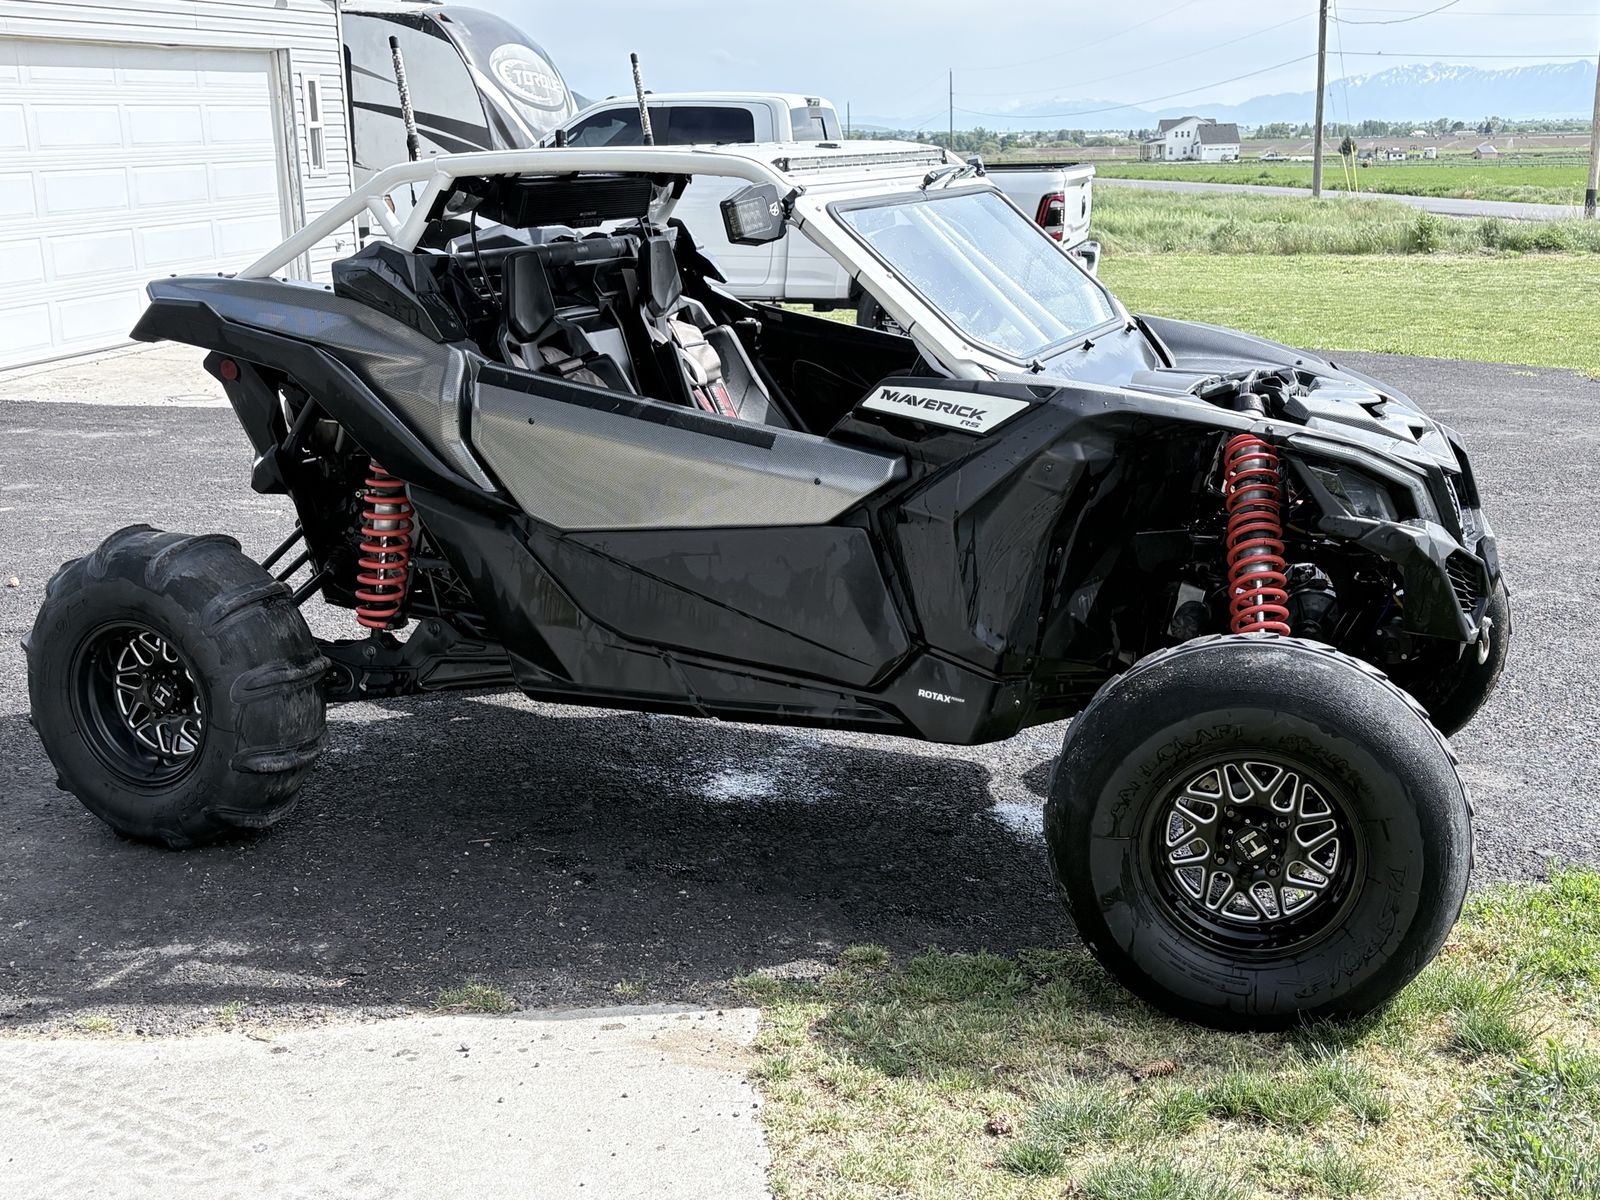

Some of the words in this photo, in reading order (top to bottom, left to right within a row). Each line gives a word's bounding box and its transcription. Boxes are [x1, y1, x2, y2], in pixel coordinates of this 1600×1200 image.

[511, 69, 562, 92] TORQUE
[880, 389, 987, 421] MAVERICK
[960, 420, 981, 428] RS
[918, 689, 951, 703] ROTAX
